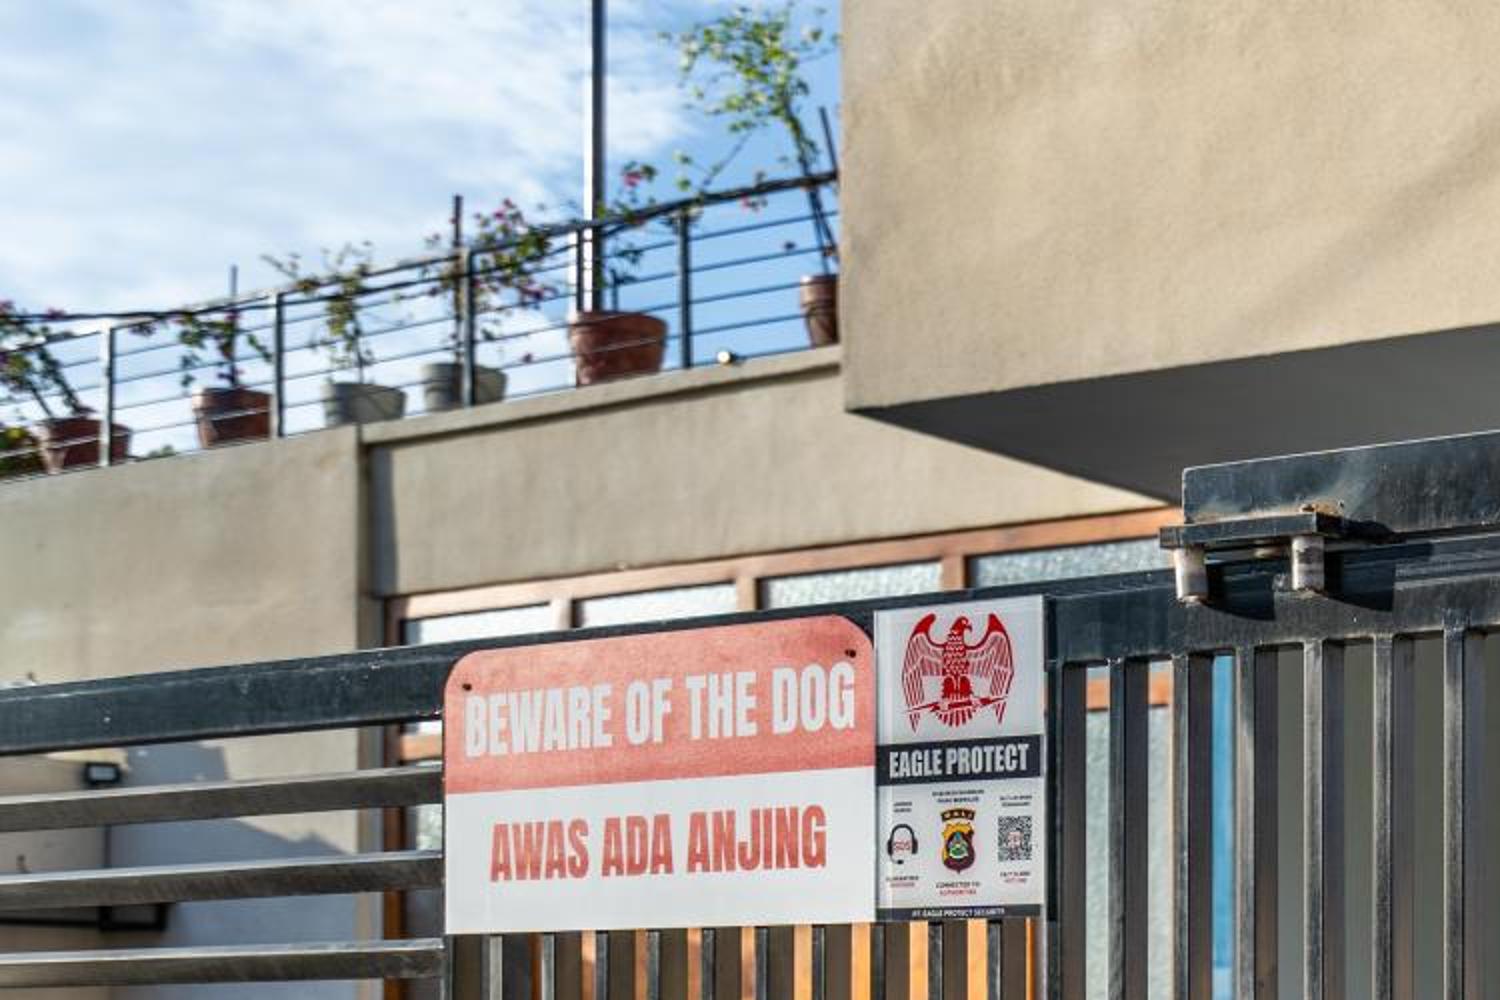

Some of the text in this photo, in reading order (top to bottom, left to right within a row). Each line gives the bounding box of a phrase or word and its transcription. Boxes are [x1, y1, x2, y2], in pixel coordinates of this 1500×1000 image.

[466, 662, 855, 757] BEWARE OF THE DOG
[889, 743, 1030, 778] EAGLE PROTECT
[490, 805, 827, 883] AWAS ADA ANJING
